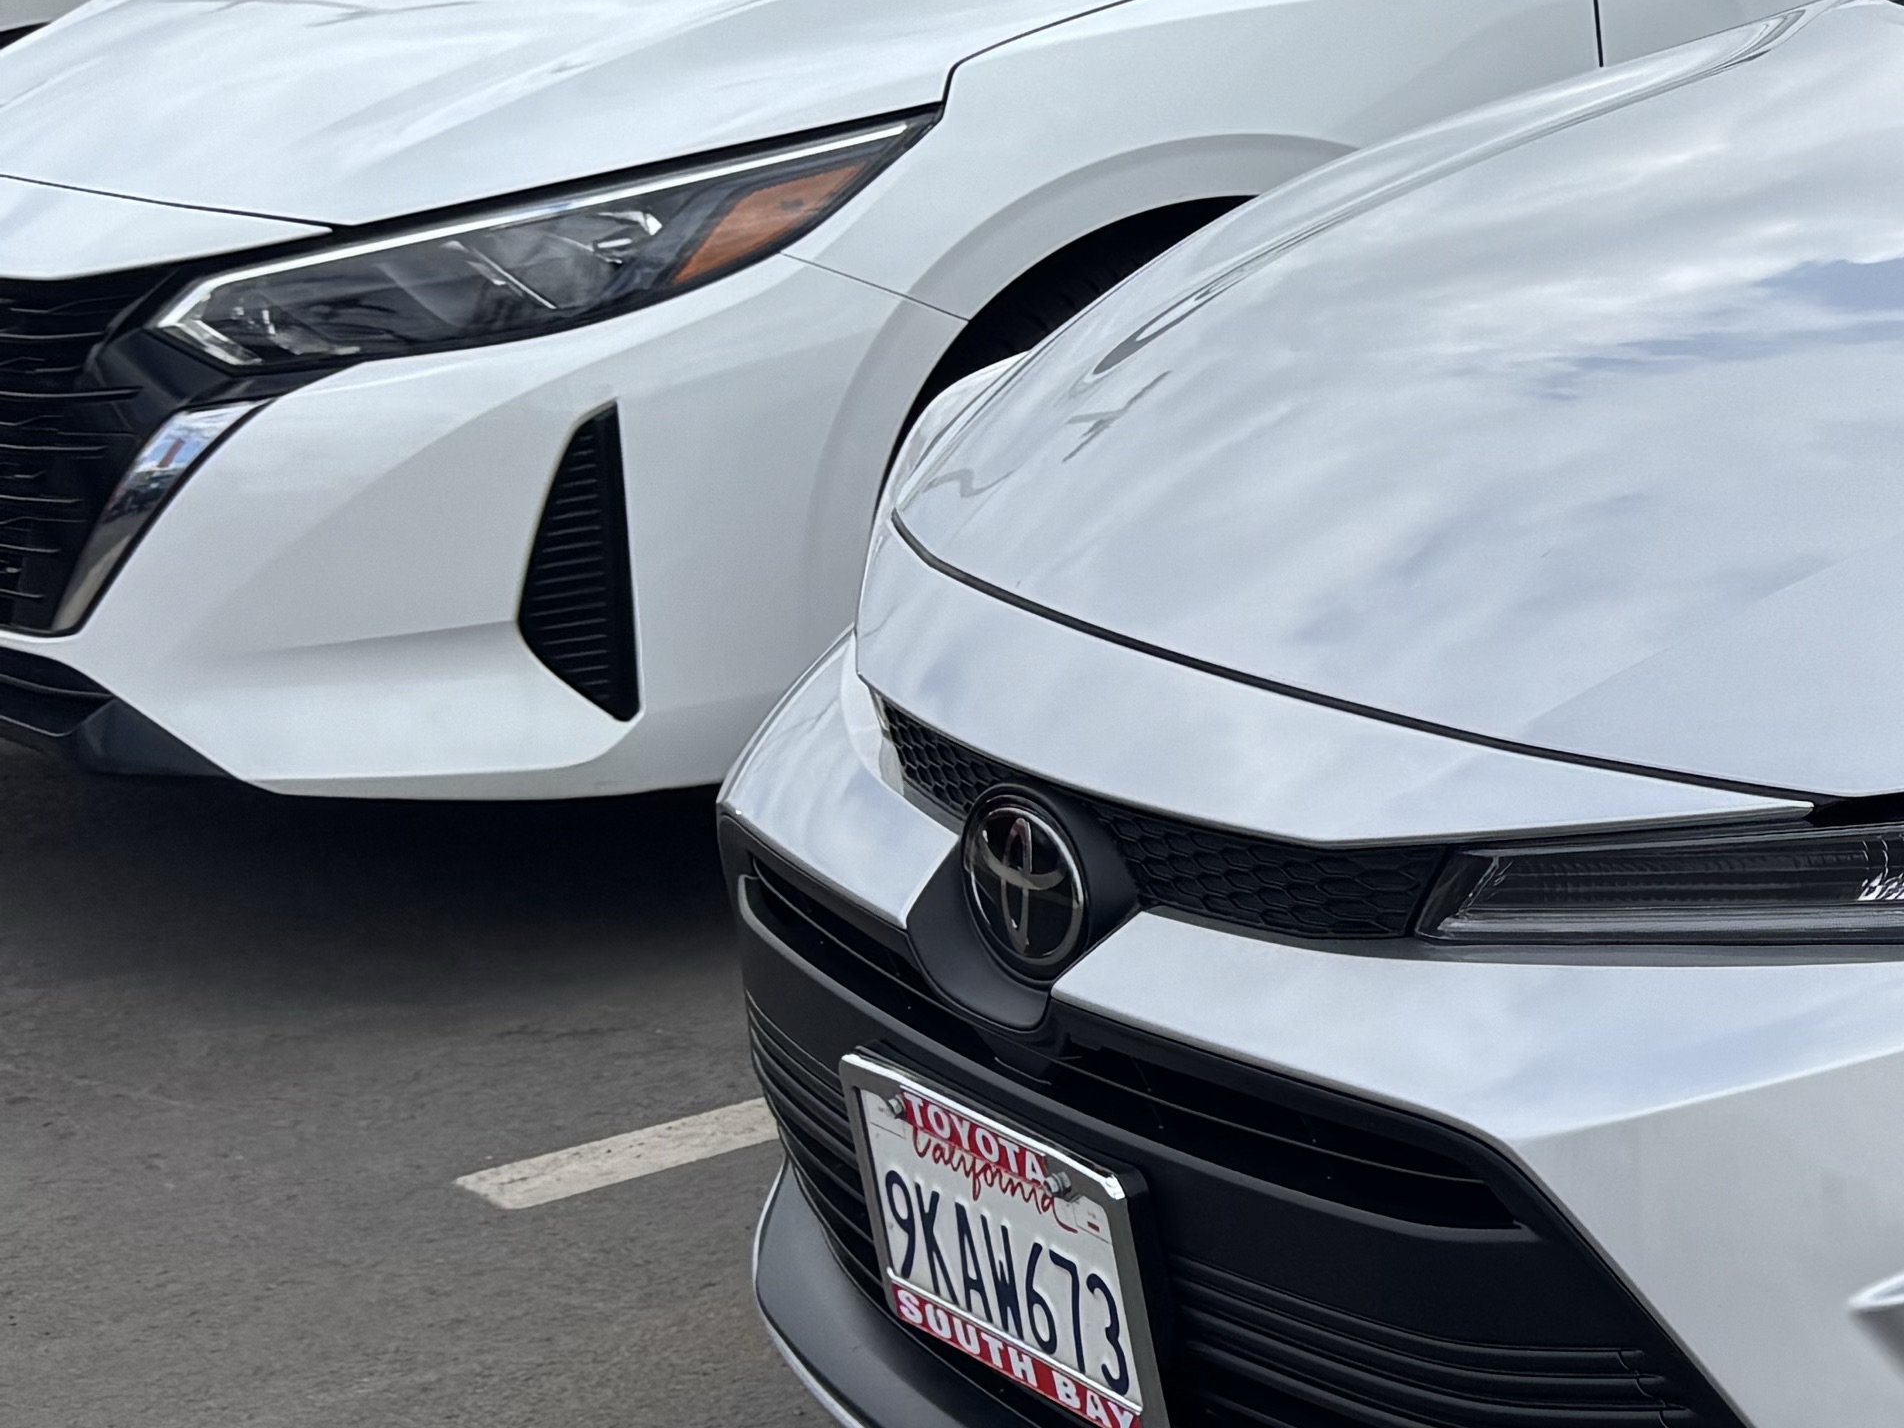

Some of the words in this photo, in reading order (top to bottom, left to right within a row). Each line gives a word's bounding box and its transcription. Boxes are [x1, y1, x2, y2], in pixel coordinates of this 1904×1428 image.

[903, 1093, 1047, 1184] TOYOTA
[885, 1169, 1130, 1397] 9KAW673
[896, 1288, 1039, 1390] SOUTH
